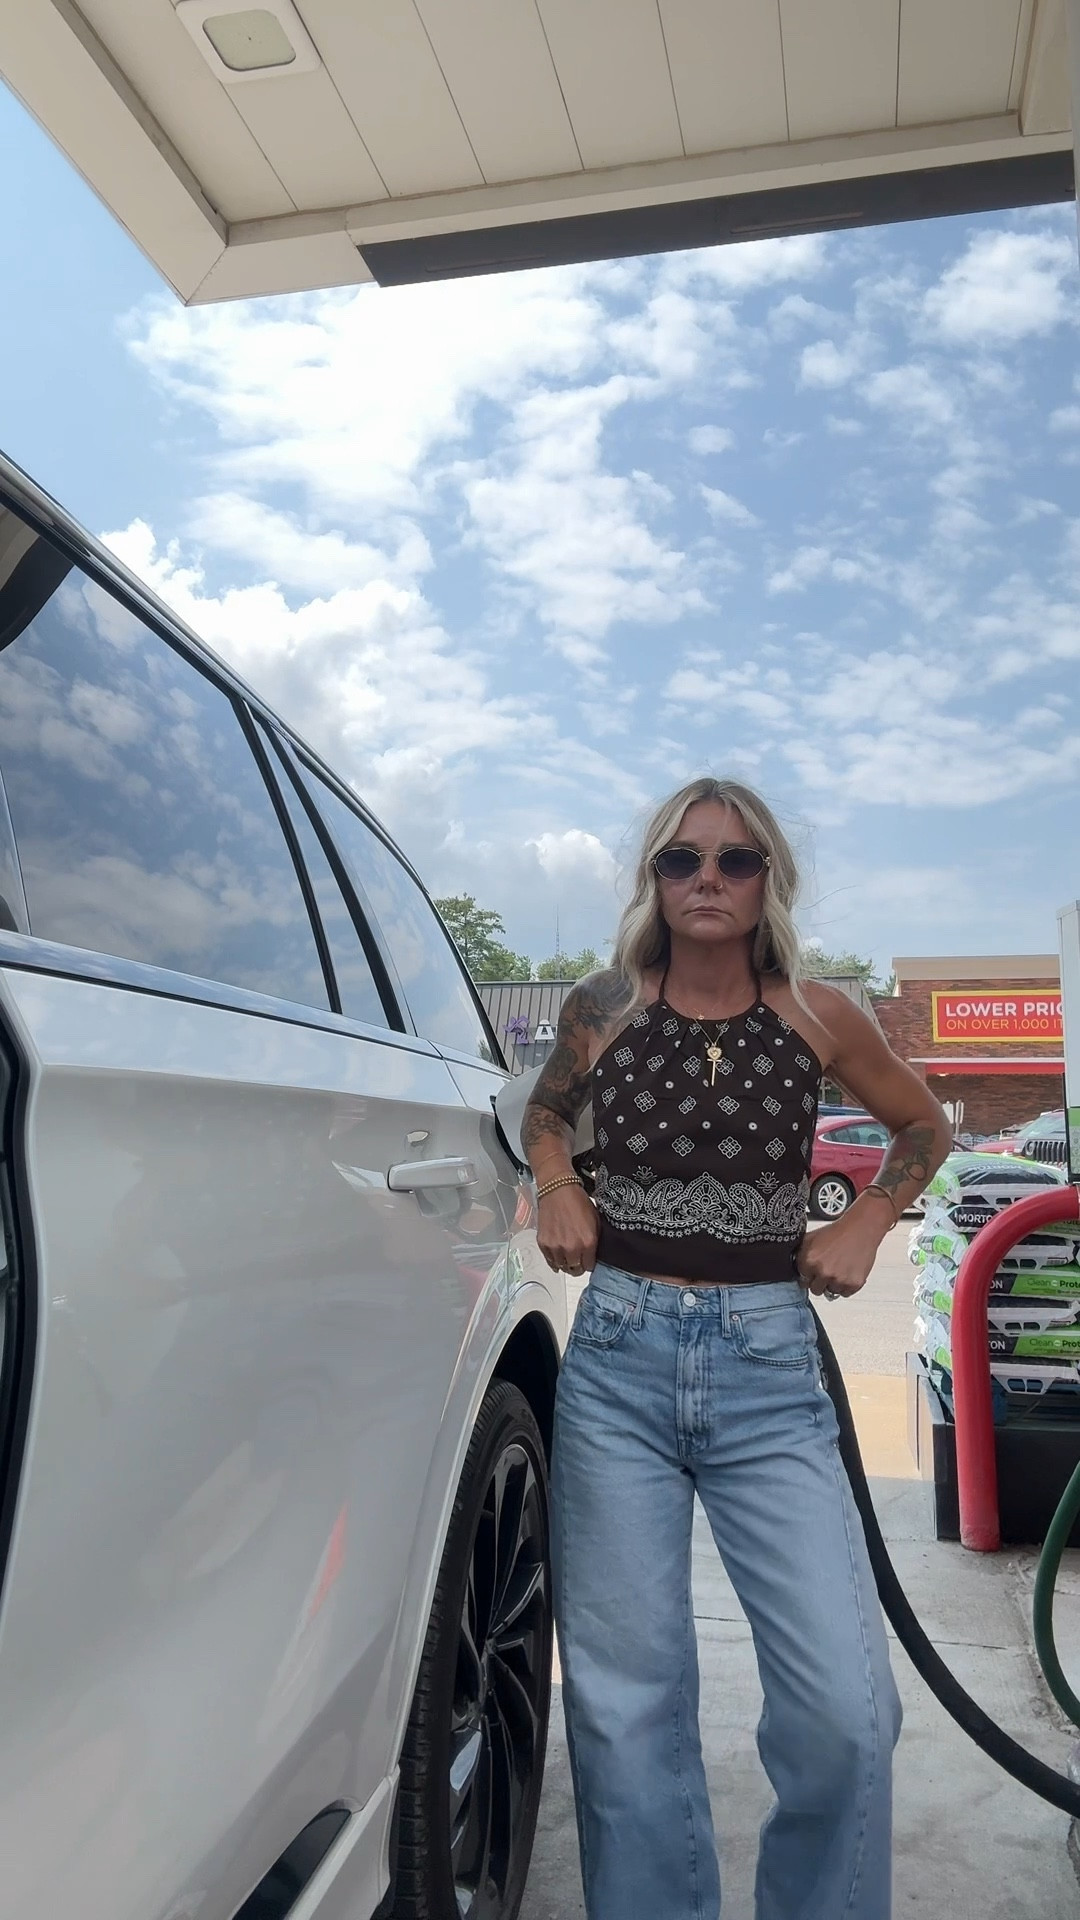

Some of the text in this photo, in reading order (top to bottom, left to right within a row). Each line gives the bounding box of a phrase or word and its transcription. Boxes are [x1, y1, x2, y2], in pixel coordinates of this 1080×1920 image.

[945, 1002, 1017, 1017] LOWER
[946, 1020, 967, 1030] ON
[971, 1019, 1009, 1030] OVER
[1013, 1018, 1049, 1031] 1,000
[989, 1340, 1006, 1350] ON
